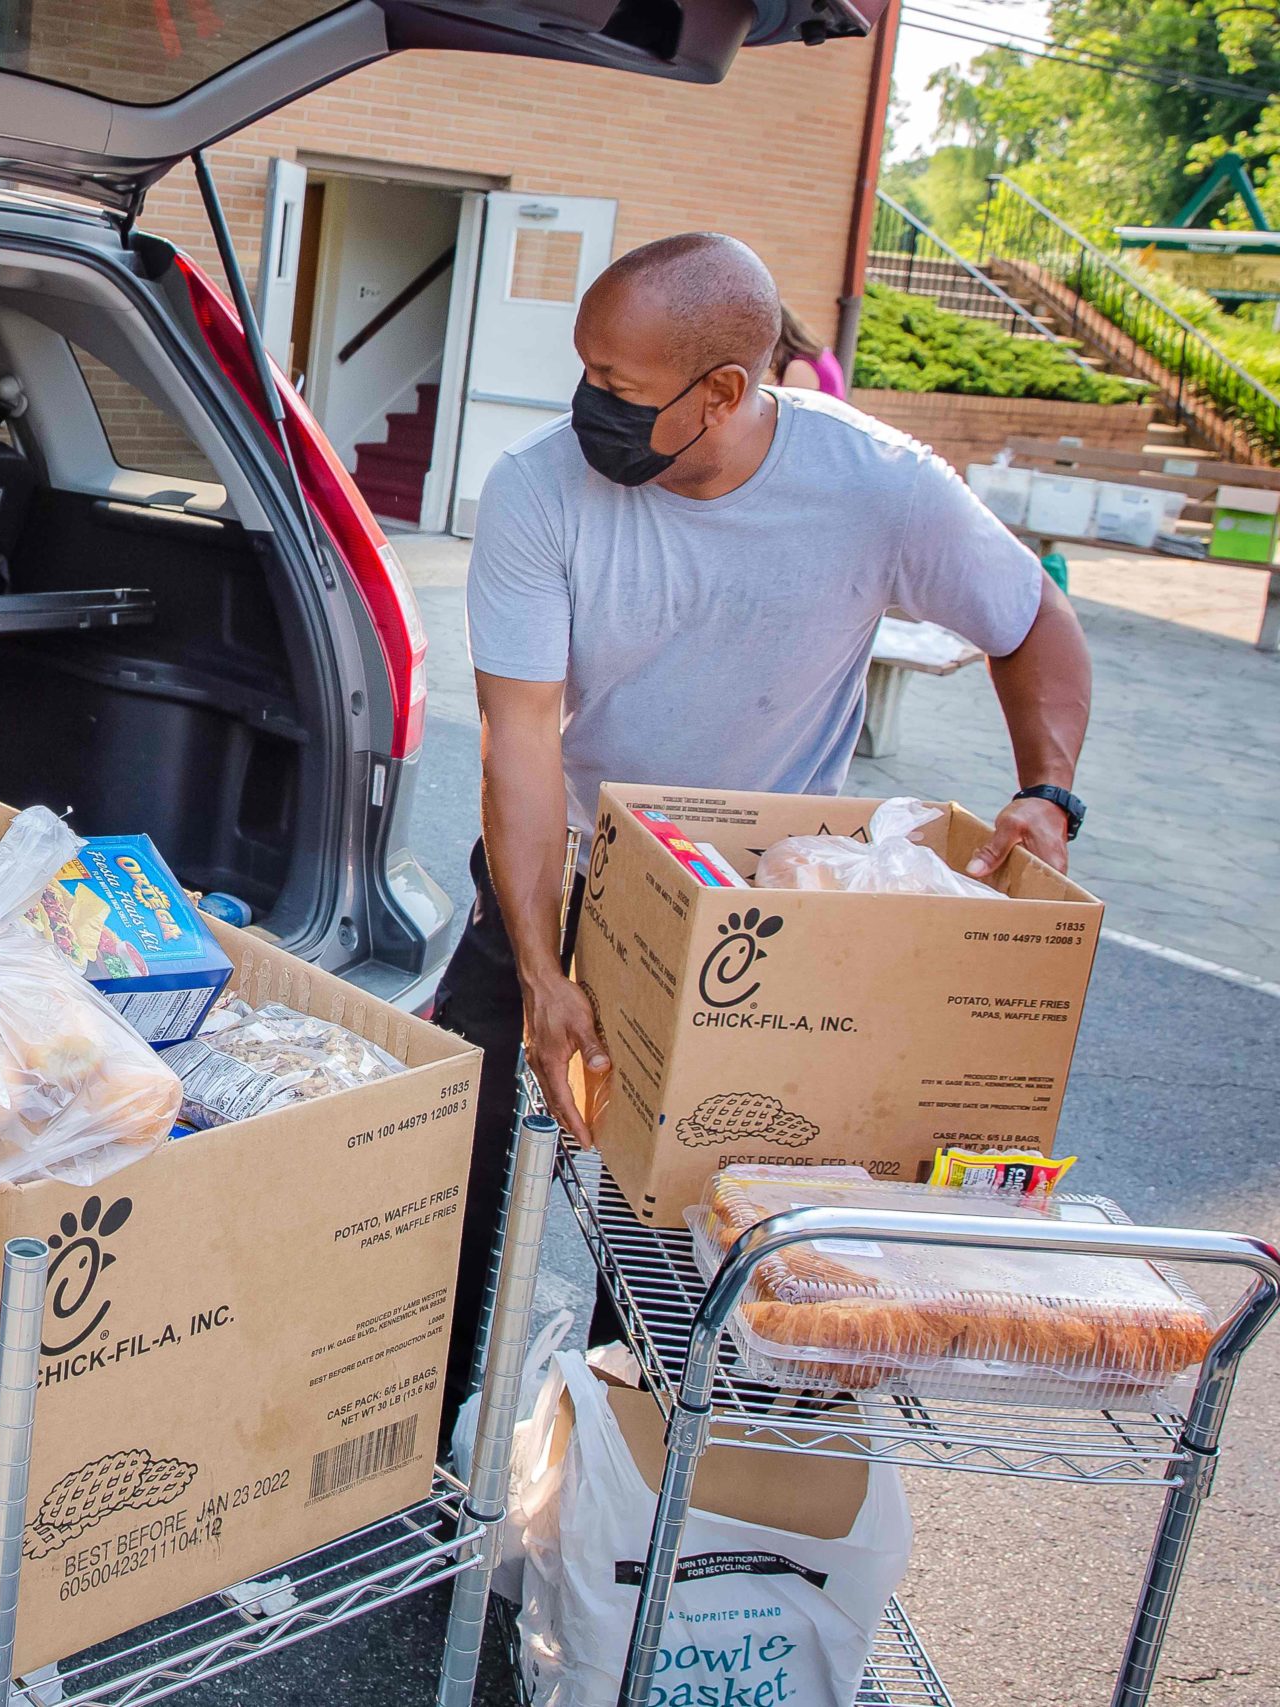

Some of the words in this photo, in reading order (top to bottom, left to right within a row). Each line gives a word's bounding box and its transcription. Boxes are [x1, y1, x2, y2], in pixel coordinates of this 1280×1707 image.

[86, 850, 121, 888] Fiesta
[114, 890, 145, 926] Flats
[140, 928, 162, 952] Kit
[116, 856, 183, 942] ORTEGA
[964, 932, 988, 941] GTIN
[992, 933, 1009, 942] 100
[1012, 934, 1042, 944] 44979
[1044, 936, 1073, 945] 12008
[1076, 937, 1082, 946] 3
[1055, 922, 1086, 932] 51835
[947, 996, 991, 1007] POTATO,
[994, 998, 1037, 1008] WAFFLE
[1040, 1000, 1070, 1010] FRIES
[971, 1010, 1002, 1020] PAPAS,
[1004, 1012, 1040, 1022] WAFFLE
[1042, 1014, 1068, 1022] FRIES
[692, 1012, 814, 1034] CHICK-FIL-A,
[820, 1016, 858, 1032] INC.
[440, 1080, 470, 1099] 51835
[347, 1131, 374, 1149] GTIN
[377, 1124, 394, 1138] 100
[398, 1112, 428, 1131] 44979
[431, 1103, 458, 1121] 12008
[461, 1100, 467, 1110] 3
[933, 1132, 956, 1140] CASE
[958, 1132, 986, 1141] PACK:
[987, 1134, 1000, 1142] 6/5
[1002, 1134, 1014, 1142] LB
[1015, 1135, 1041, 1144] BAGS,
[869, 1160, 900, 1176] 2022
[334, 1217, 381, 1242] POTATO,
[384, 1198, 428, 1222] WAFFLE
[430, 1185, 459, 1205] FRIES
[360, 1230, 392, 1248] PAPAS,
[395, 1214, 430, 1235] WAFFLE
[432, 1204, 457, 1221] FRIES
[190, 1304, 234, 1336] INC.
[356, 1311, 392, 1330] PRODUCED
[392, 1306, 402, 1316] BY
[402, 1298, 421, 1312] LAMB
[422, 1288, 448, 1304] WESTON
[311, 1346, 326, 1357] 8701
[328, 1342, 336, 1352] W.
[336, 1334, 356, 1348] GAGE
[378, 1308, 418, 1330] KENNEWICK,
[419, 1304, 429, 1314] WA
[310, 1375, 328, 1387] BEST
[328, 1363, 356, 1379] BEFORE
[356, 1354, 374, 1368] DATE
[374, 1350, 385, 1360] OR
[386, 1334, 426, 1356] PRODUCTION
[428, 1326, 443, 1338] DATE
[327, 1402, 352, 1420] CASE
[354, 1390, 382, 1408] PACK:
[384, 1384, 397, 1396] 6/5
[398, 1378, 410, 1390] LB
[412, 1366, 438, 1384] BAGS,
[340, 1412, 360, 1428] NET
[362, 1406, 376, 1418] WT
[377, 1400, 387, 1412] 30
[389, 1394, 401, 1407] LB
[402, 1384, 423, 1403] (13.6
[424, 1378, 438, 1394] kg)
[64, 1539, 113, 1578] BEST
[117, 1508, 189, 1556] BEFORE
[196, 1492, 229, 1524] JAN
[232, 1484, 250, 1508] 23
[252, 1469, 290, 1500] 2022
[677, 1560, 696, 1570] TURN
[697, 1558, 707, 1567] TO
[688, 1568, 704, 1578] FOR
[706, 1563, 754, 1576] RECYCLING.
[668, 1610, 676, 1620] A
[744, 1606, 782, 1619] BRAND
[758, 1634, 797, 1662] &
